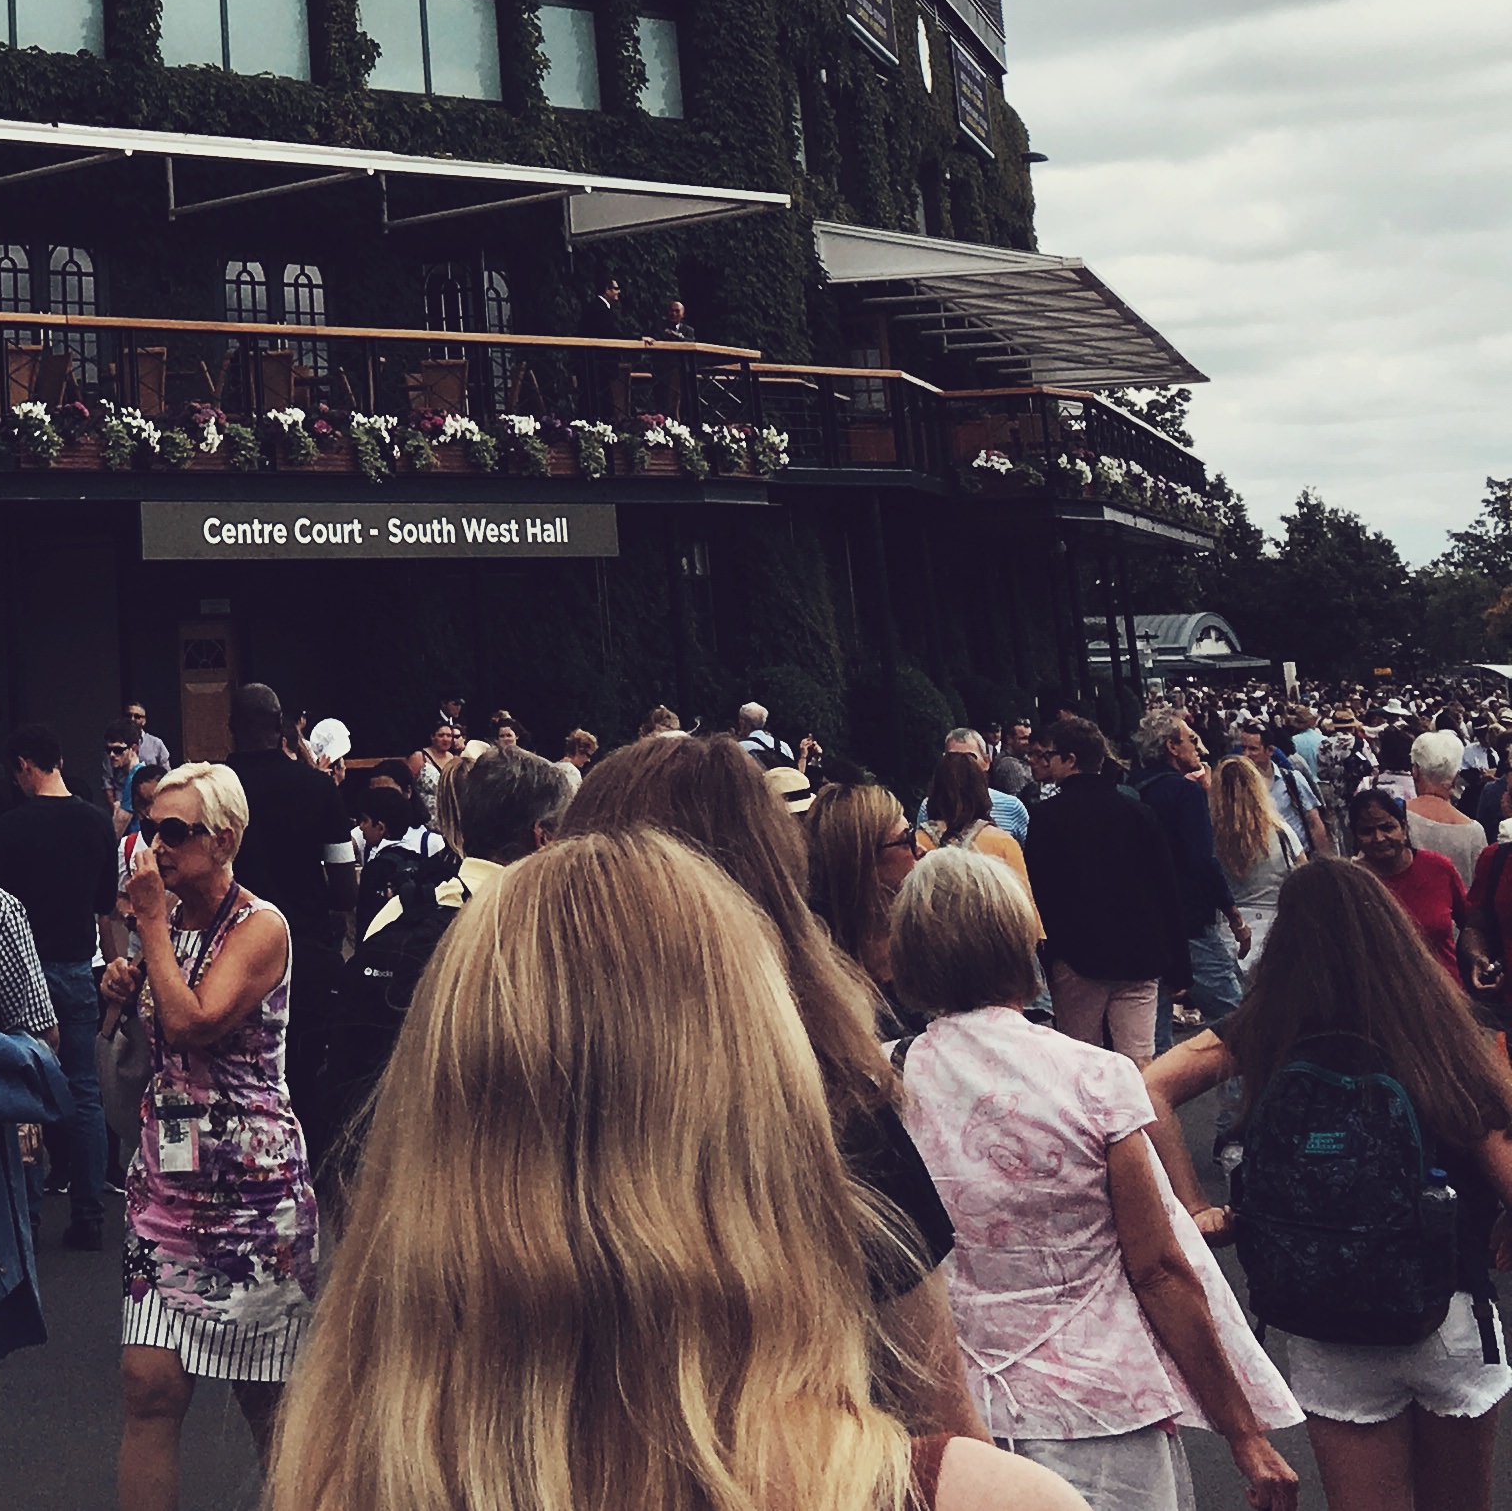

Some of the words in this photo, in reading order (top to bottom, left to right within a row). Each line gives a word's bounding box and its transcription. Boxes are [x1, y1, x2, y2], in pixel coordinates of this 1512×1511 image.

[203, 517, 288, 545] Centre
[294, 517, 363, 545] Court
[387, 517, 456, 544] South
[461, 517, 520, 544] West
[525, 517, 569, 543] Hall
